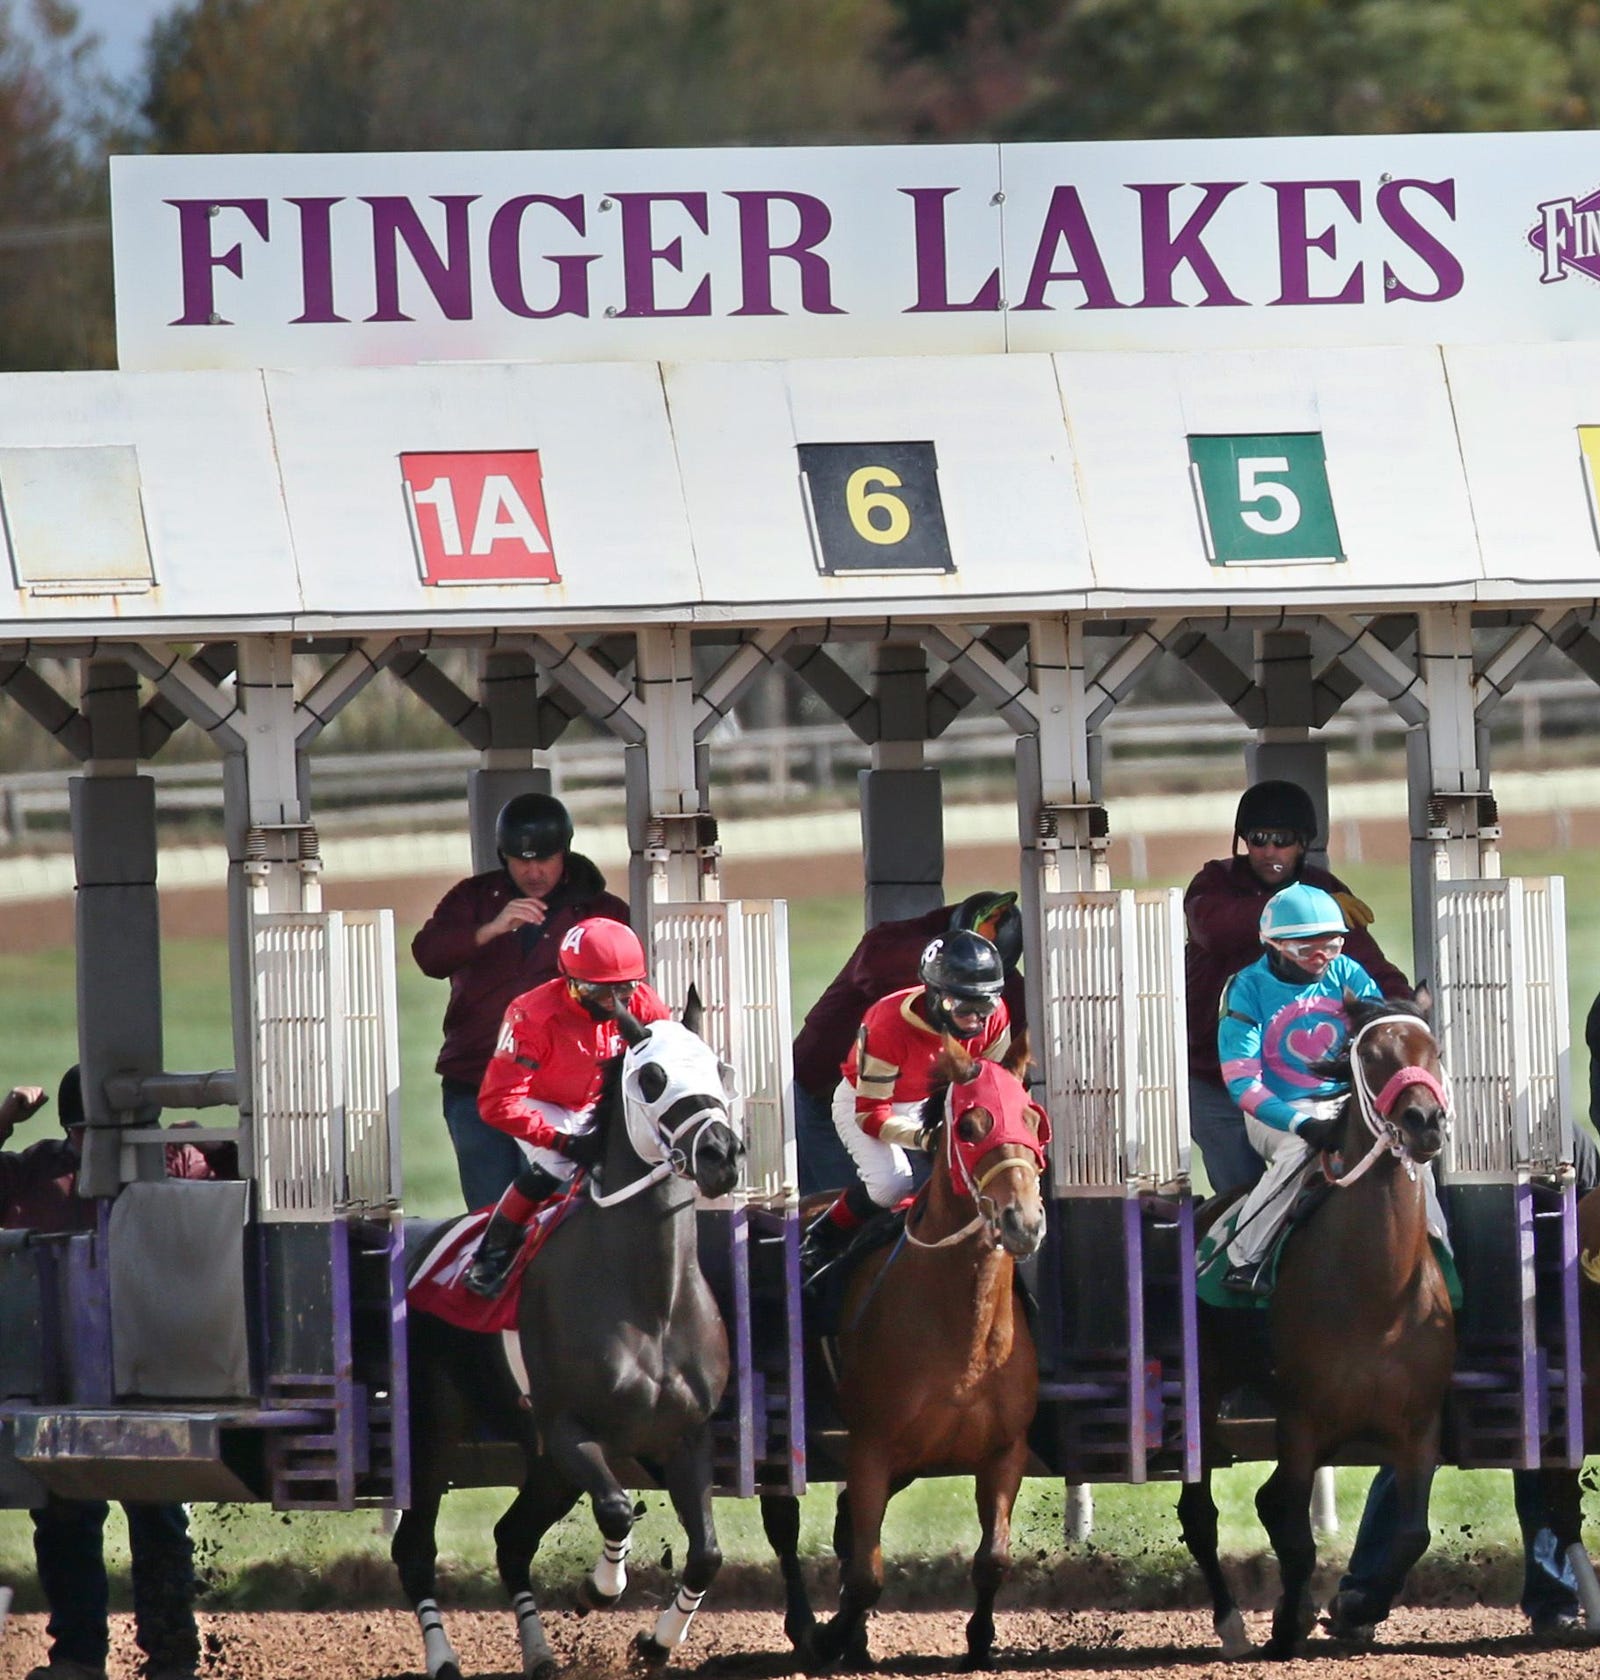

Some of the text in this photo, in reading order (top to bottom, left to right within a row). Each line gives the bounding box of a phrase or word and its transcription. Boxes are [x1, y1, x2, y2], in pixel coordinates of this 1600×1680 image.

[163, 180, 1465, 326] FINGER LAKES
[413, 474, 550, 559] 1A
[845, 465, 912, 546] 6
[1238, 456, 1301, 535] 5
[560, 925, 585, 955] 1A
[924, 939, 944, 963] 6
